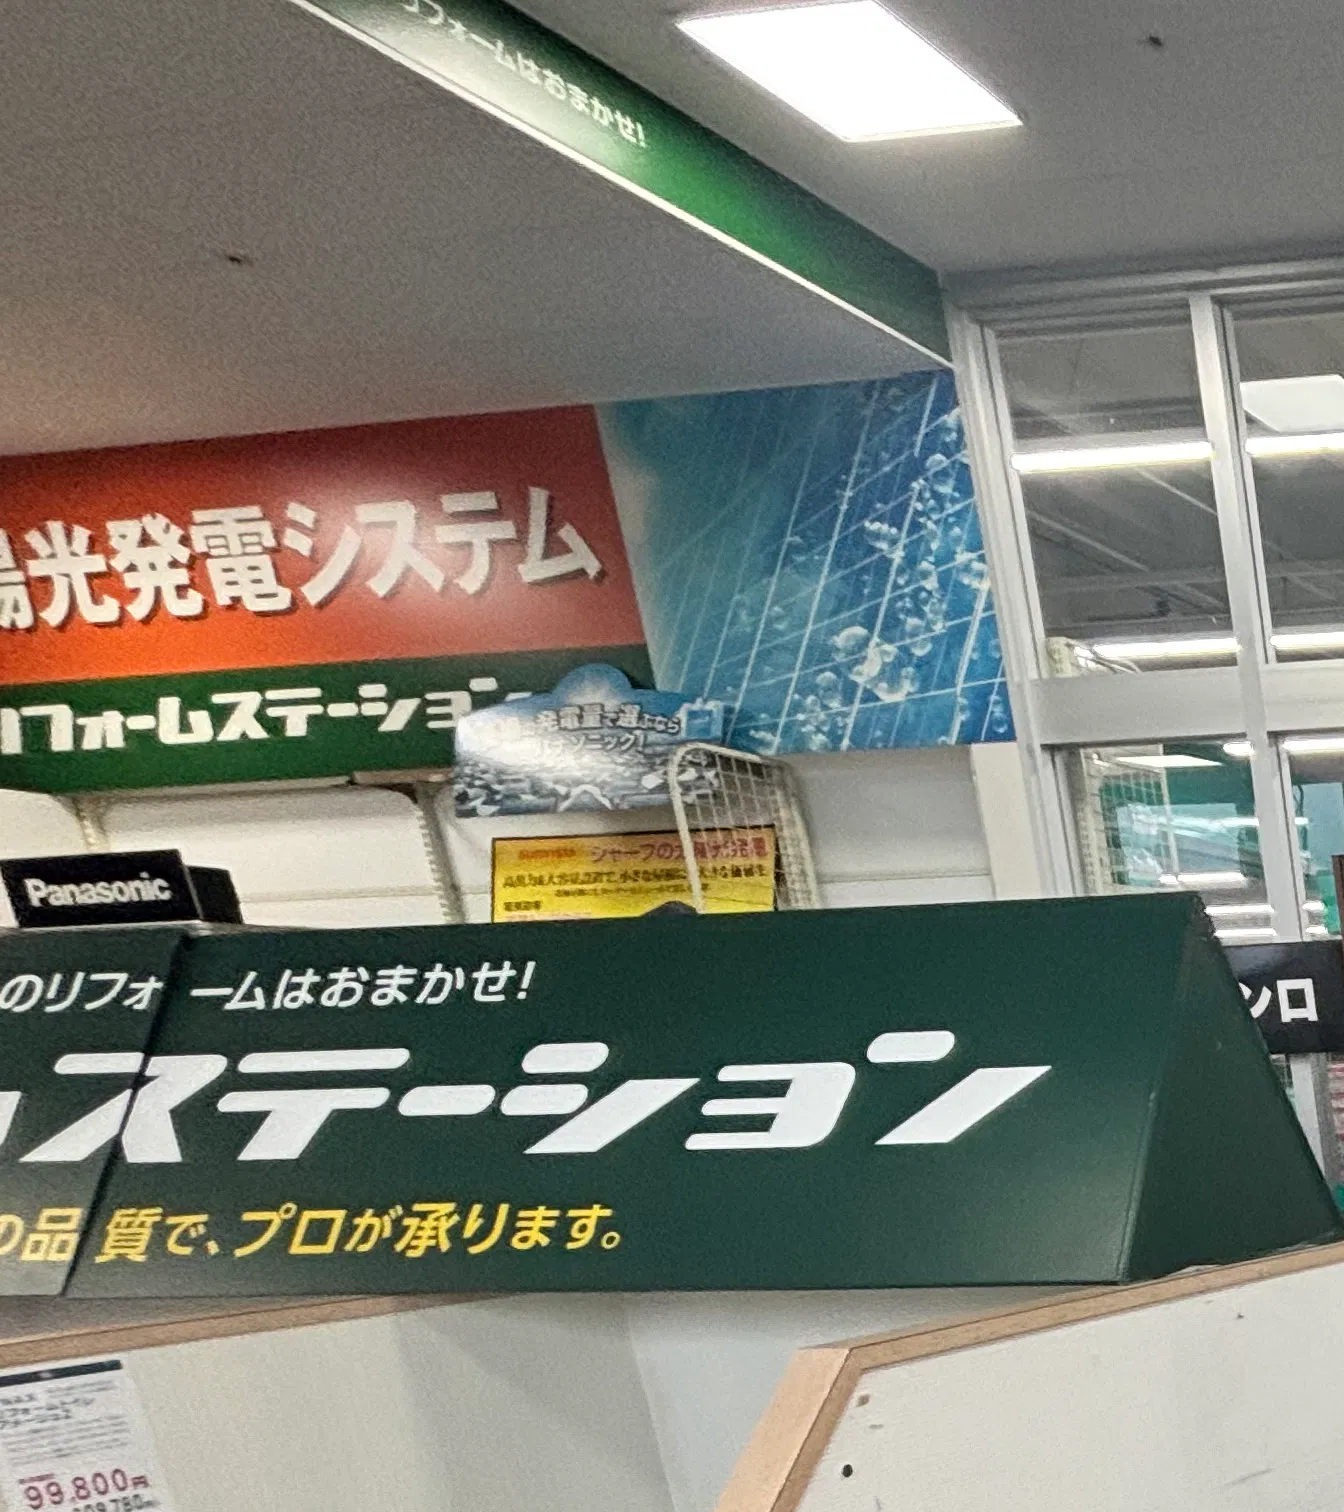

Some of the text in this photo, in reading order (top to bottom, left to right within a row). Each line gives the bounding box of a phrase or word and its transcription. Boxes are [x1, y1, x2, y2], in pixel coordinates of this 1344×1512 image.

[0, 675, 532, 756] フォームステーショ
[24, 873, 173, 908] Panasonic
[3, 960, 537, 1014] のリフォームはおまかせ!
[0, 1030, 1053, 1164] ステーション
